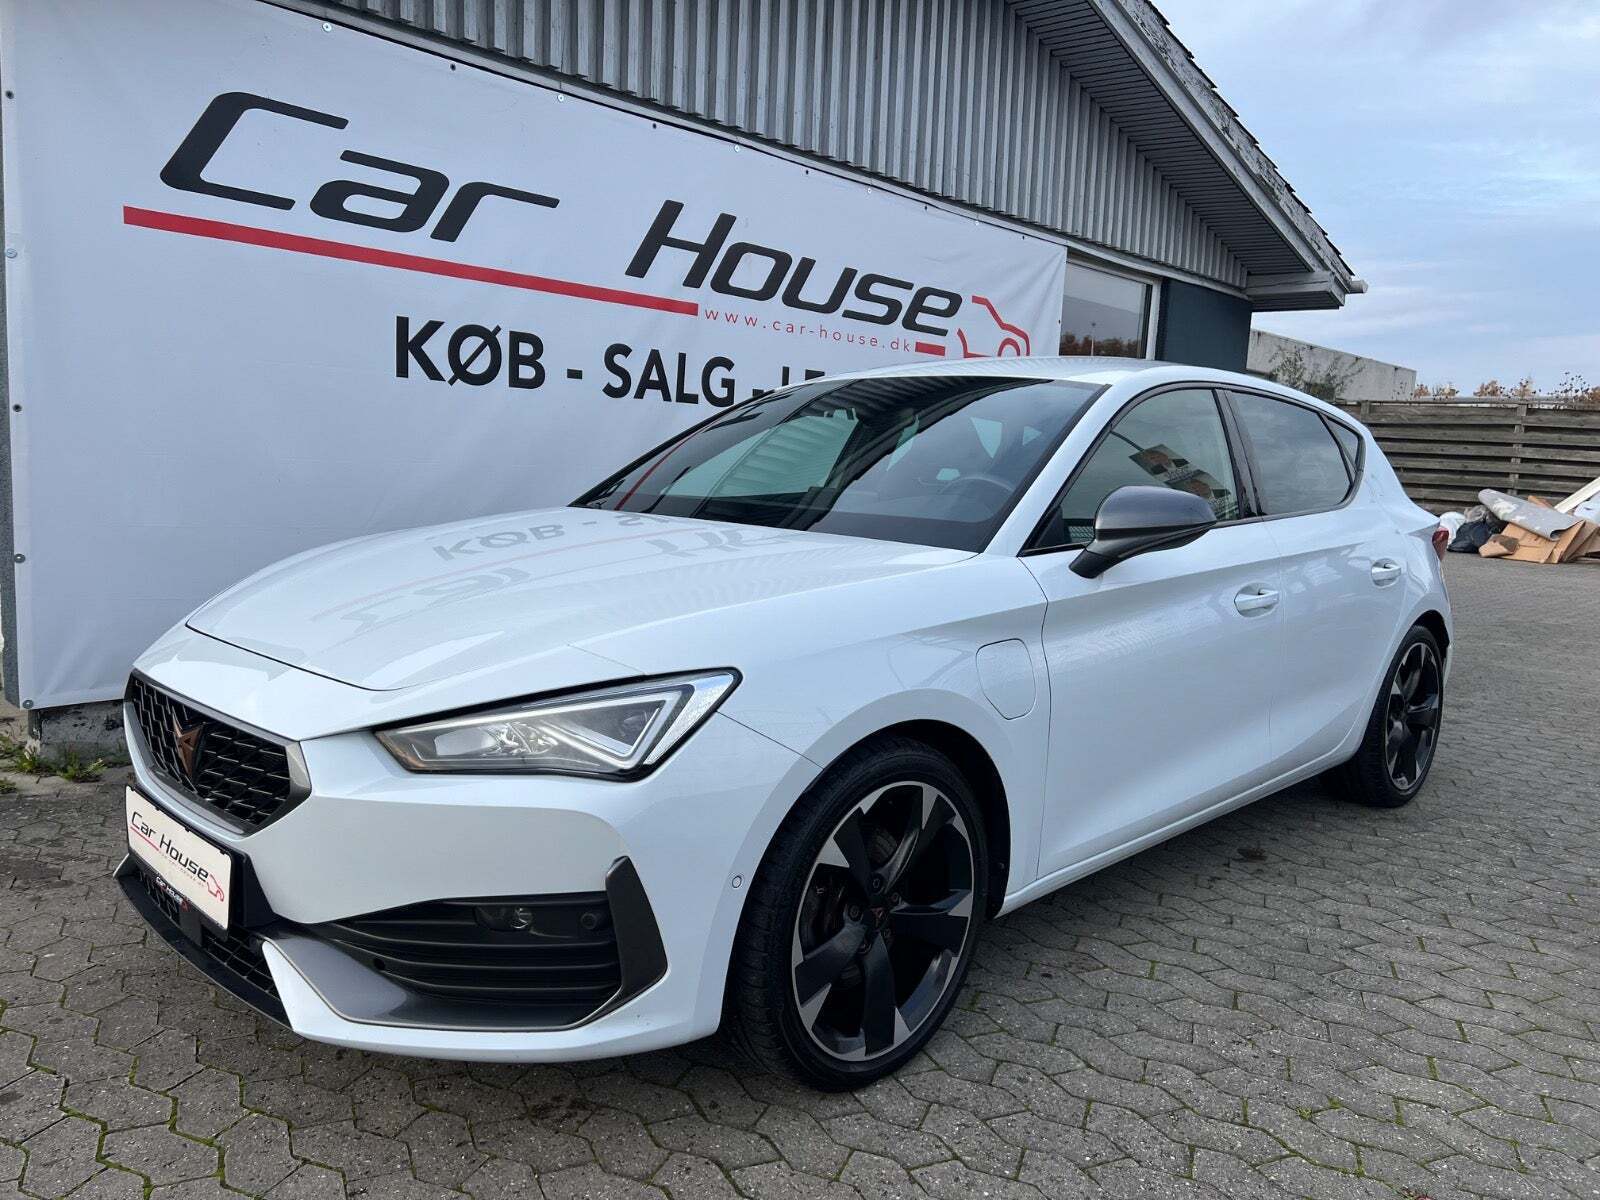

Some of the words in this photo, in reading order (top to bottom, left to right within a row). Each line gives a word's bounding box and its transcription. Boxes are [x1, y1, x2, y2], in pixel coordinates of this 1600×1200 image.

[160, 91, 560, 242] Car
[625, 199, 963, 337] House
[395, 315, 546, 389] KØB
[602, 343, 736, 407] SALG
[704, 309, 911, 352] www.car-house.dk
[132, 811, 156, 838] Car
[159, 834, 208, 883] House
